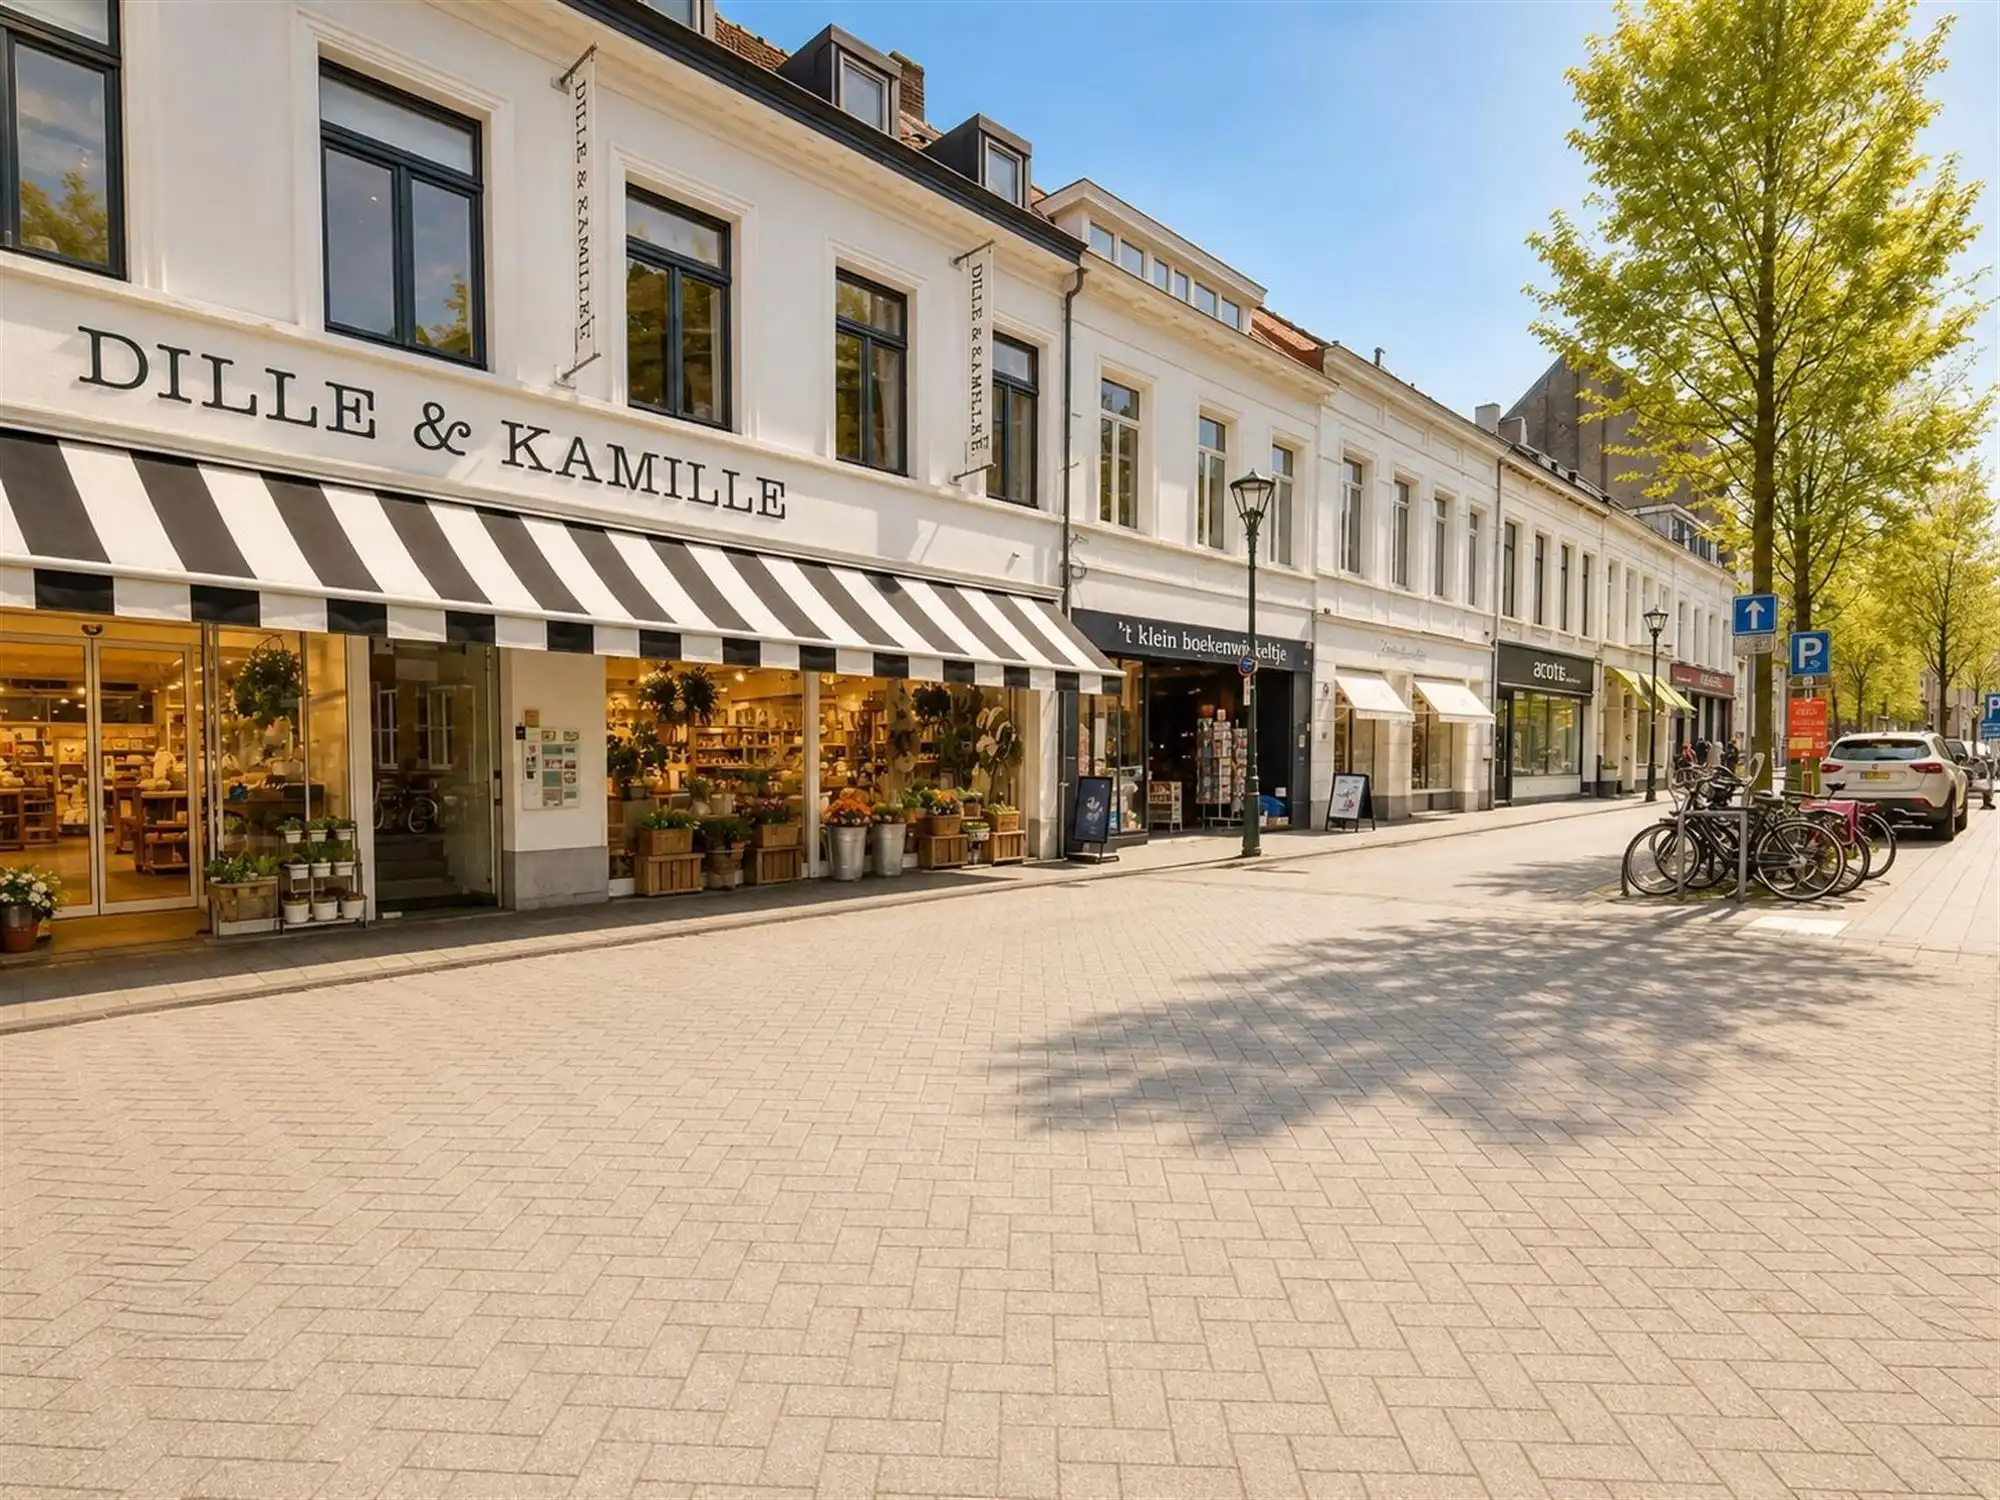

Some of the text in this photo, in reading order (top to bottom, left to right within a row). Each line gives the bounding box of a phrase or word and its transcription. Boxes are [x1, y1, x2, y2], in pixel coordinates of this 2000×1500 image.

[575, 79, 588, 165] DILLE
[971, 263, 984, 322] DILLE
[77, 325, 787, 520] DILLE & KAMILLE
[1138, 624, 1178, 649] klein
[1182, 631, 1288, 666] boekenwikeltje
[1799, 637, 1823, 669] P
